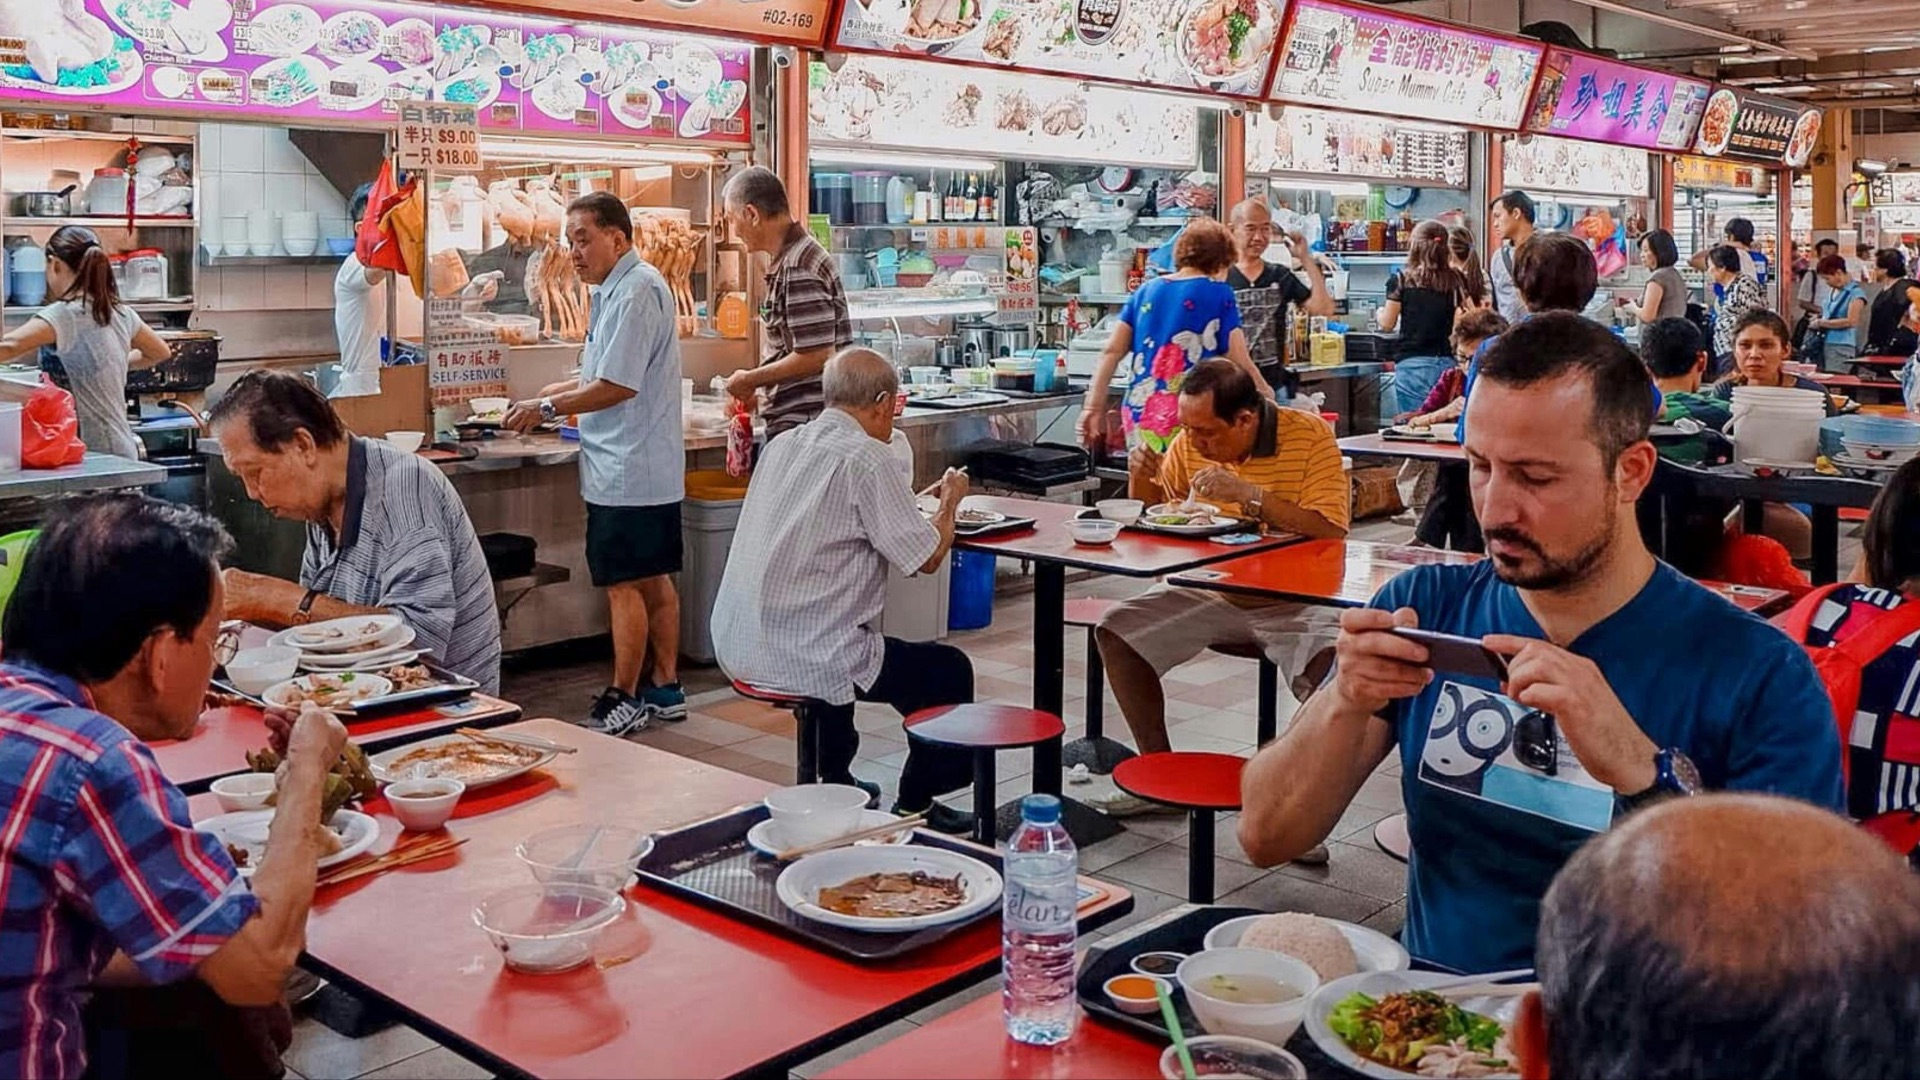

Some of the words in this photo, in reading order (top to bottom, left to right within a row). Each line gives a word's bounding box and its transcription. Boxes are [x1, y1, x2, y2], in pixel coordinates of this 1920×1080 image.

[763, 9, 813, 28] #02-169
[1571, 69, 1668, 132] 珍姐美食
[404, 125, 434, 144] 半只
[438, 129, 476, 144] $9.00
[405, 147, 433, 165] 一只
[436, 149, 478, 165] $18.00
[433, 367, 506, 383] SELF-SERVICE
